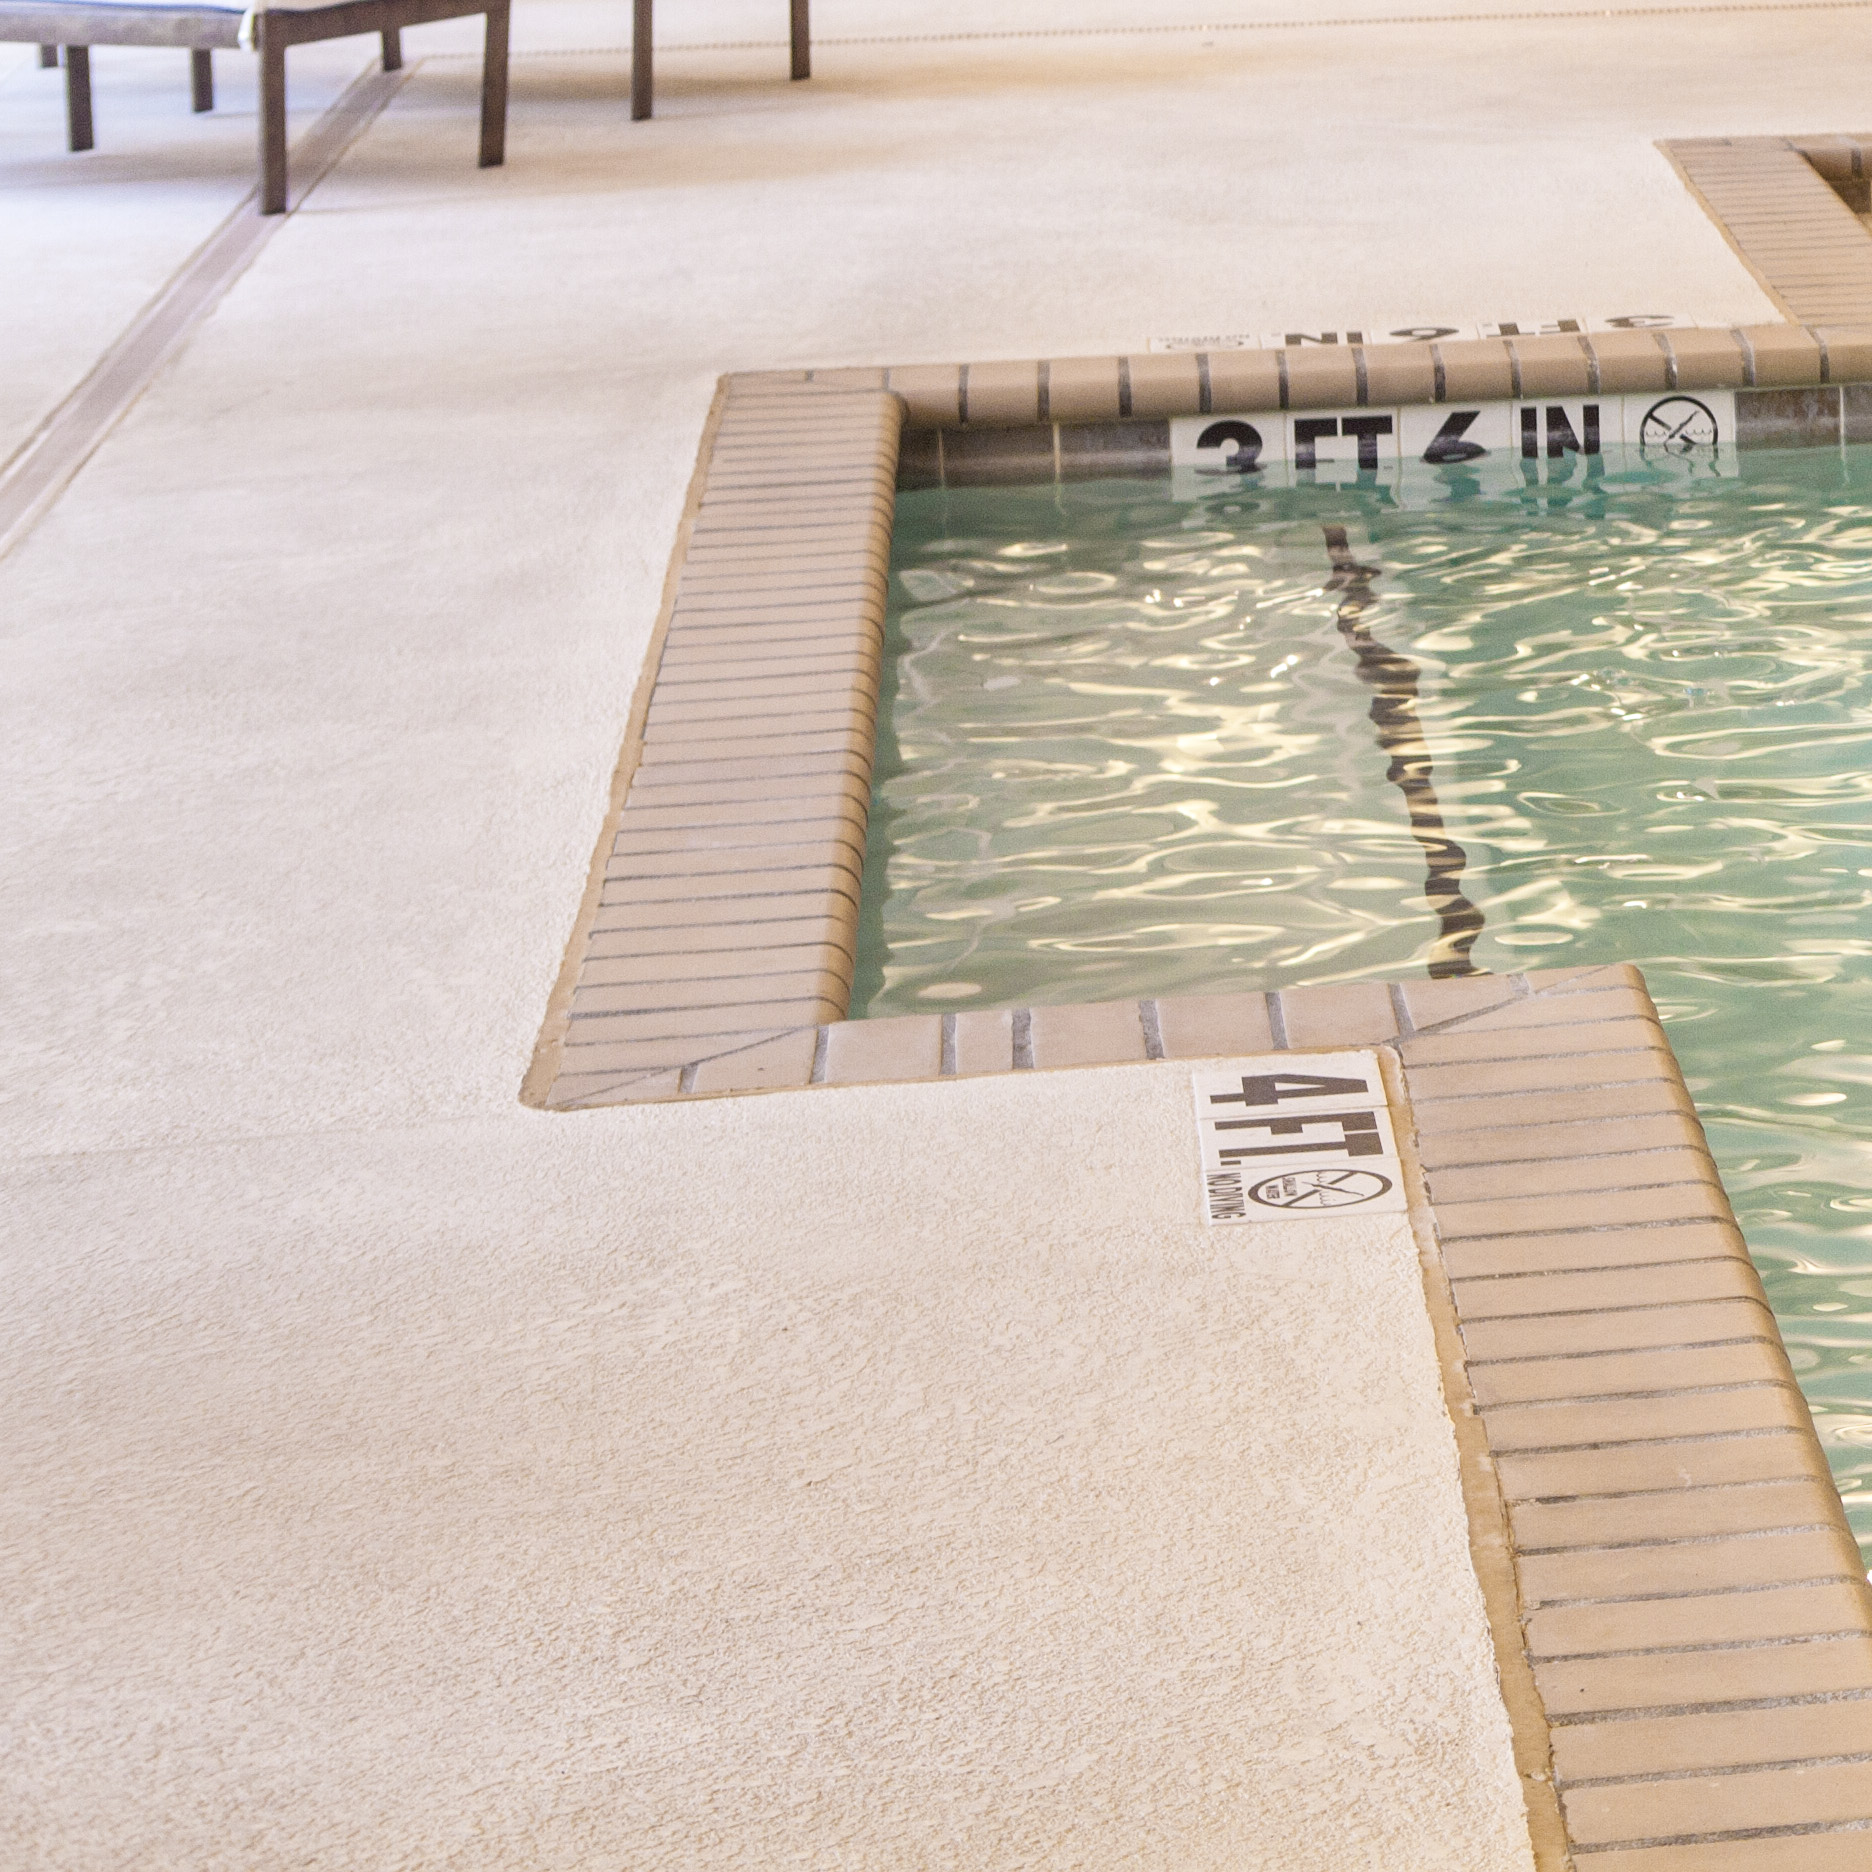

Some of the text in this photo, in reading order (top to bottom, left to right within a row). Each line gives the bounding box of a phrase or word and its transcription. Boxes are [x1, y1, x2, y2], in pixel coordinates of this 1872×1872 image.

[1210, 1073, 1369, 1107] 4
[1206, 1172, 1247, 1219] NO DIVING
